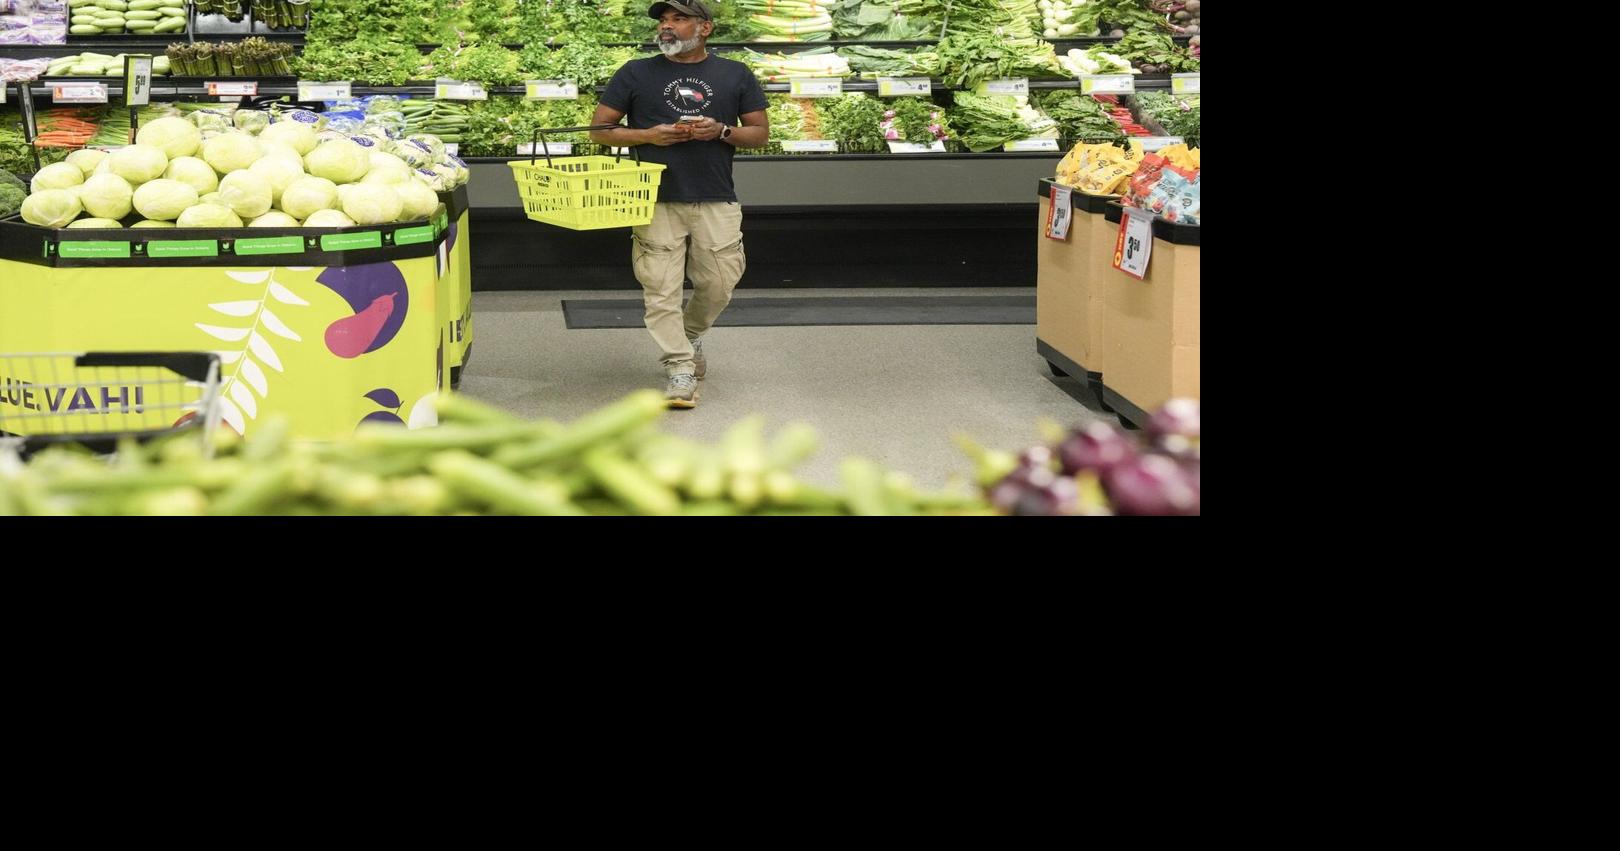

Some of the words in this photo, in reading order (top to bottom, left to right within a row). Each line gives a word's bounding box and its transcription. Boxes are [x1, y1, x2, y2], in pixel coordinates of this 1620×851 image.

[664, 78, 683, 96] TOMMY
[686, 77, 714, 97] HILFIGER
[45, 386, 144, 414] VAH!
